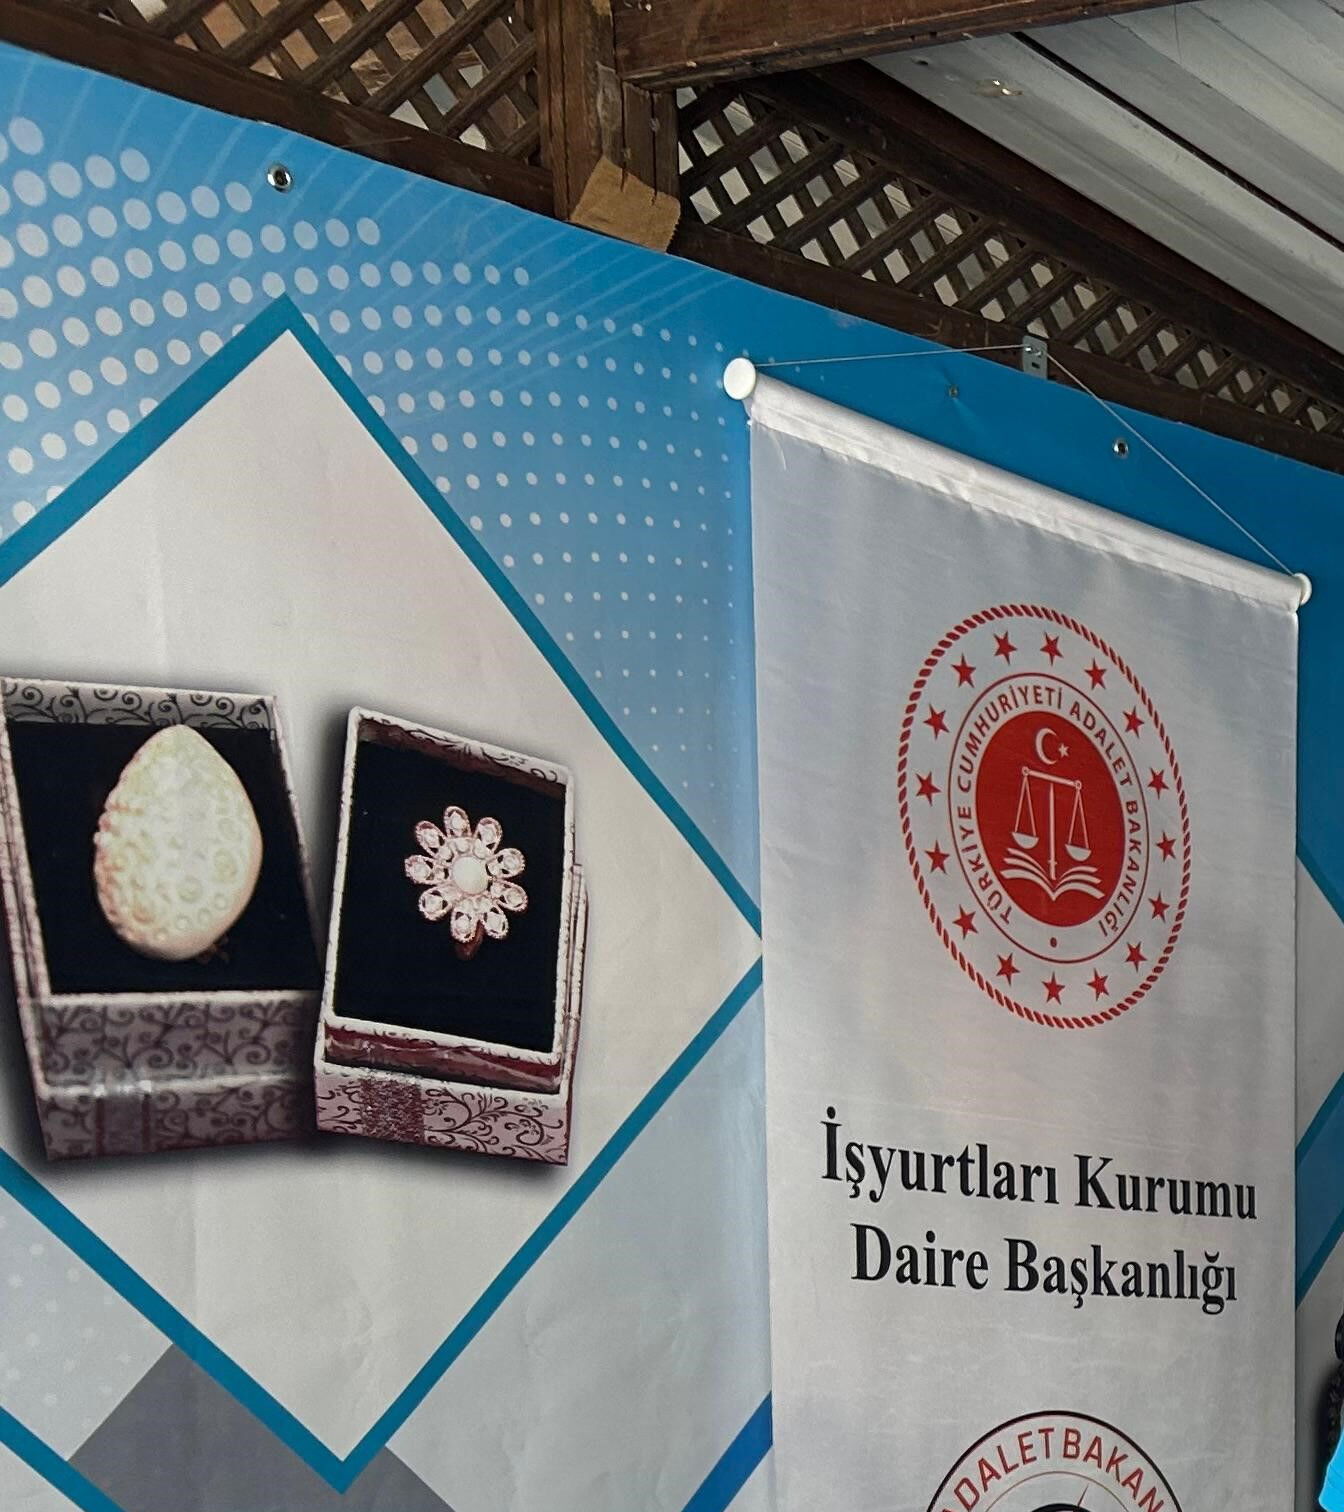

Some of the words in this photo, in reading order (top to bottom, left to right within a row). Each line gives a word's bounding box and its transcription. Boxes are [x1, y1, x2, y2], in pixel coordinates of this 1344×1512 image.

[957, 684, 1063, 794] CUMHURİYETİ
[1069, 701, 1133, 787] ADALET
[958, 805, 1013, 925] TÜRKİYE
[1098, 800, 1142, 937] BAKANLIĞI
[820, 1106, 1058, 1206] İşyurtları
[1073, 1153, 1258, 1220] Kurumu
[850, 1222, 989, 1290] Daire
[1003, 1237, 1237, 1315] Başkanlığı
